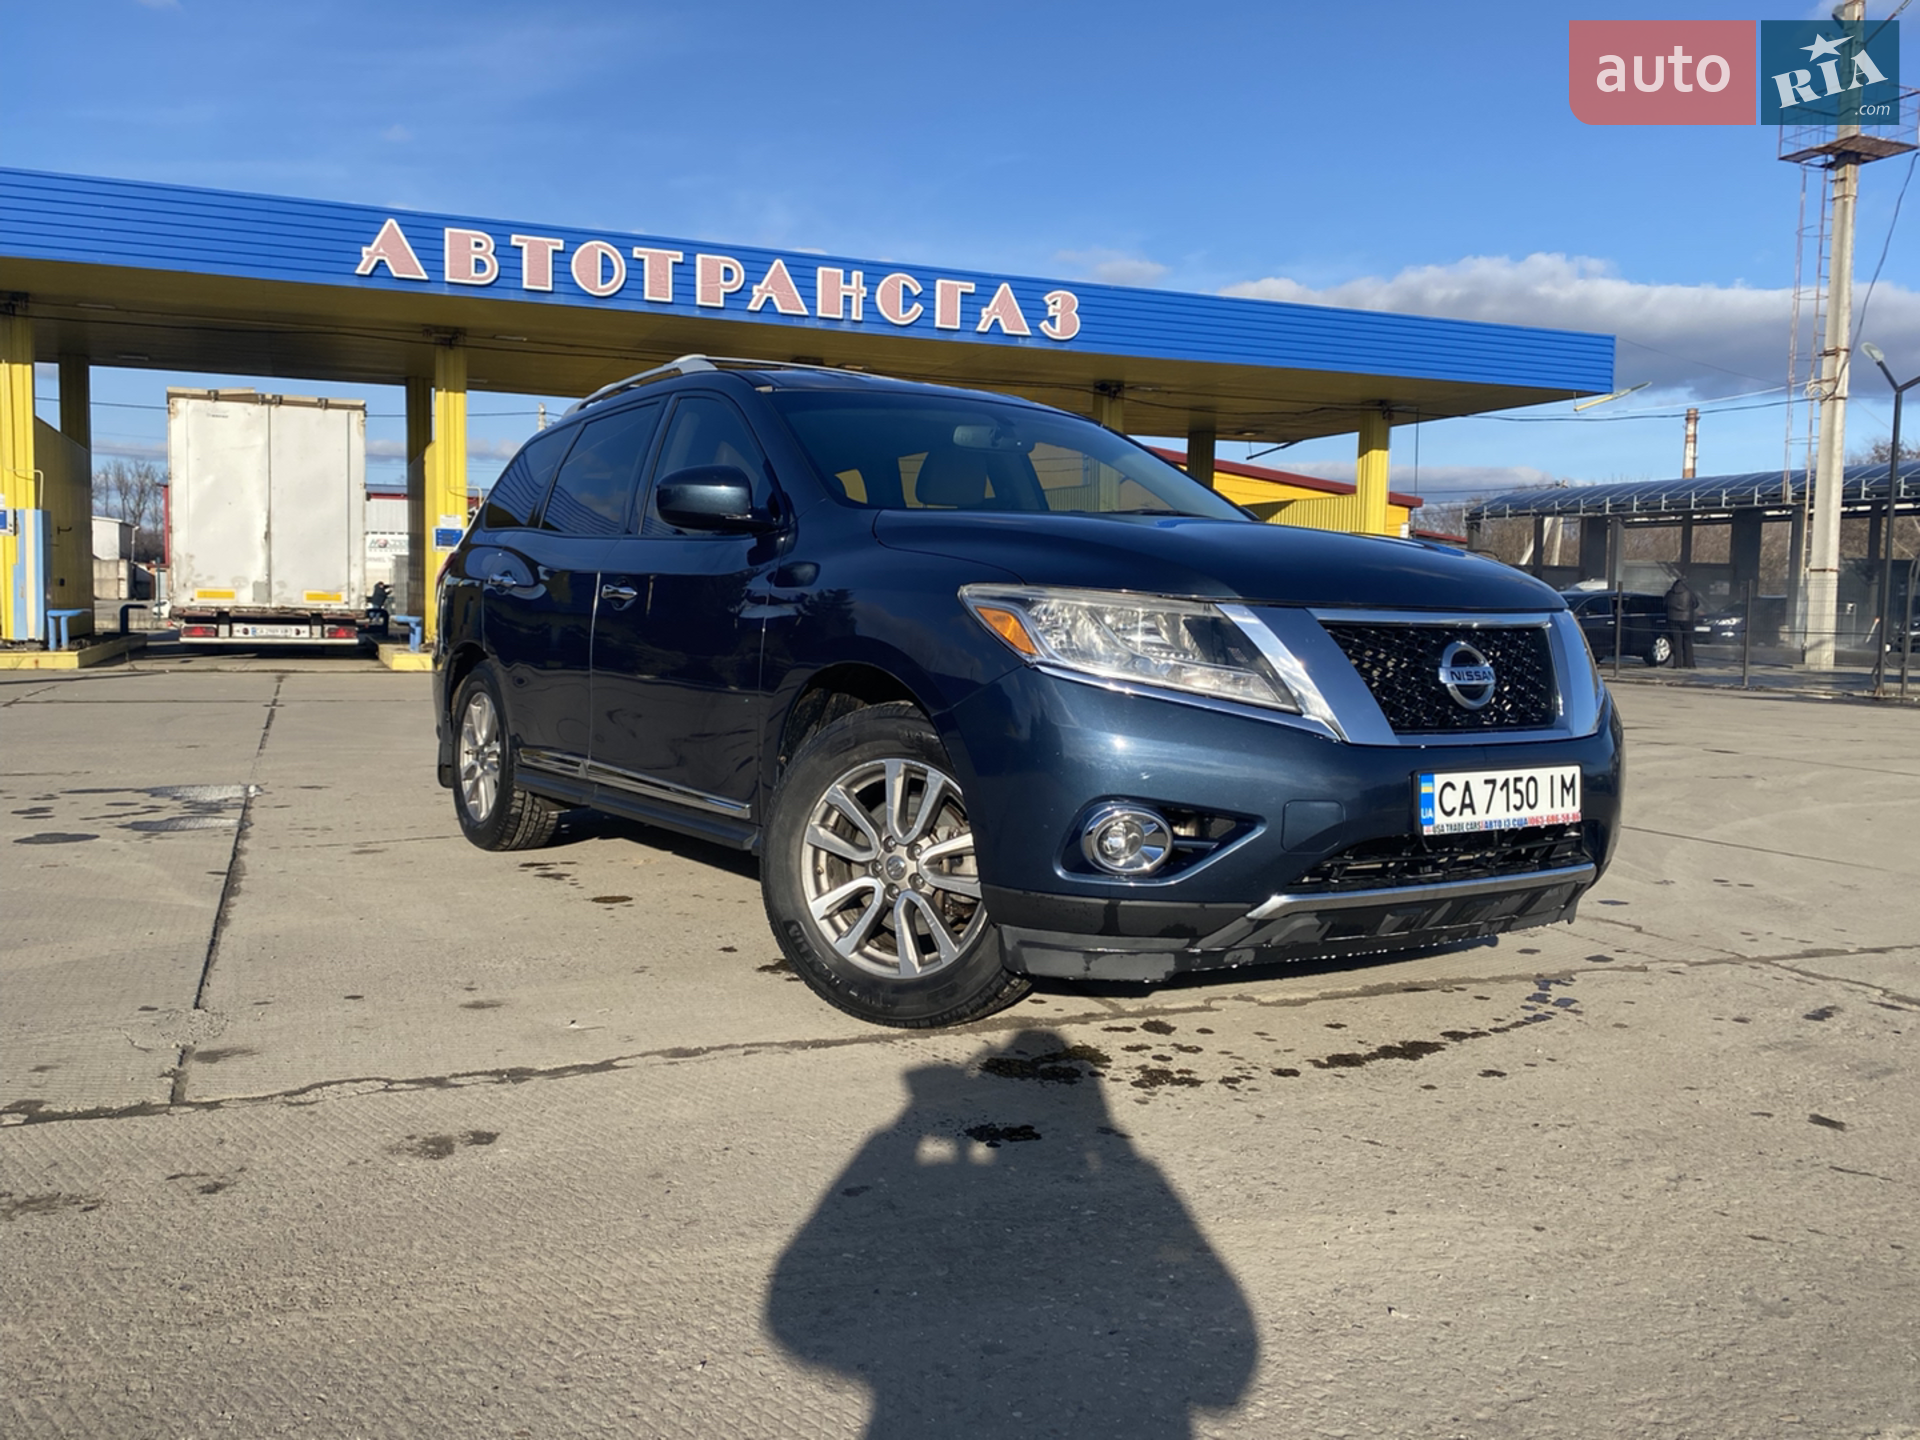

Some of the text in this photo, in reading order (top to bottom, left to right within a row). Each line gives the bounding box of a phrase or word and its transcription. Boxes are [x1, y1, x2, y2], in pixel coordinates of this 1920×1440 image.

[354, 217, 1081, 343] АВТОТРАНСГАЗ
[1421, 808, 1433, 820] UA
[1439, 780, 1476, 817] CA
[1483, 775, 1539, 815] 7150
